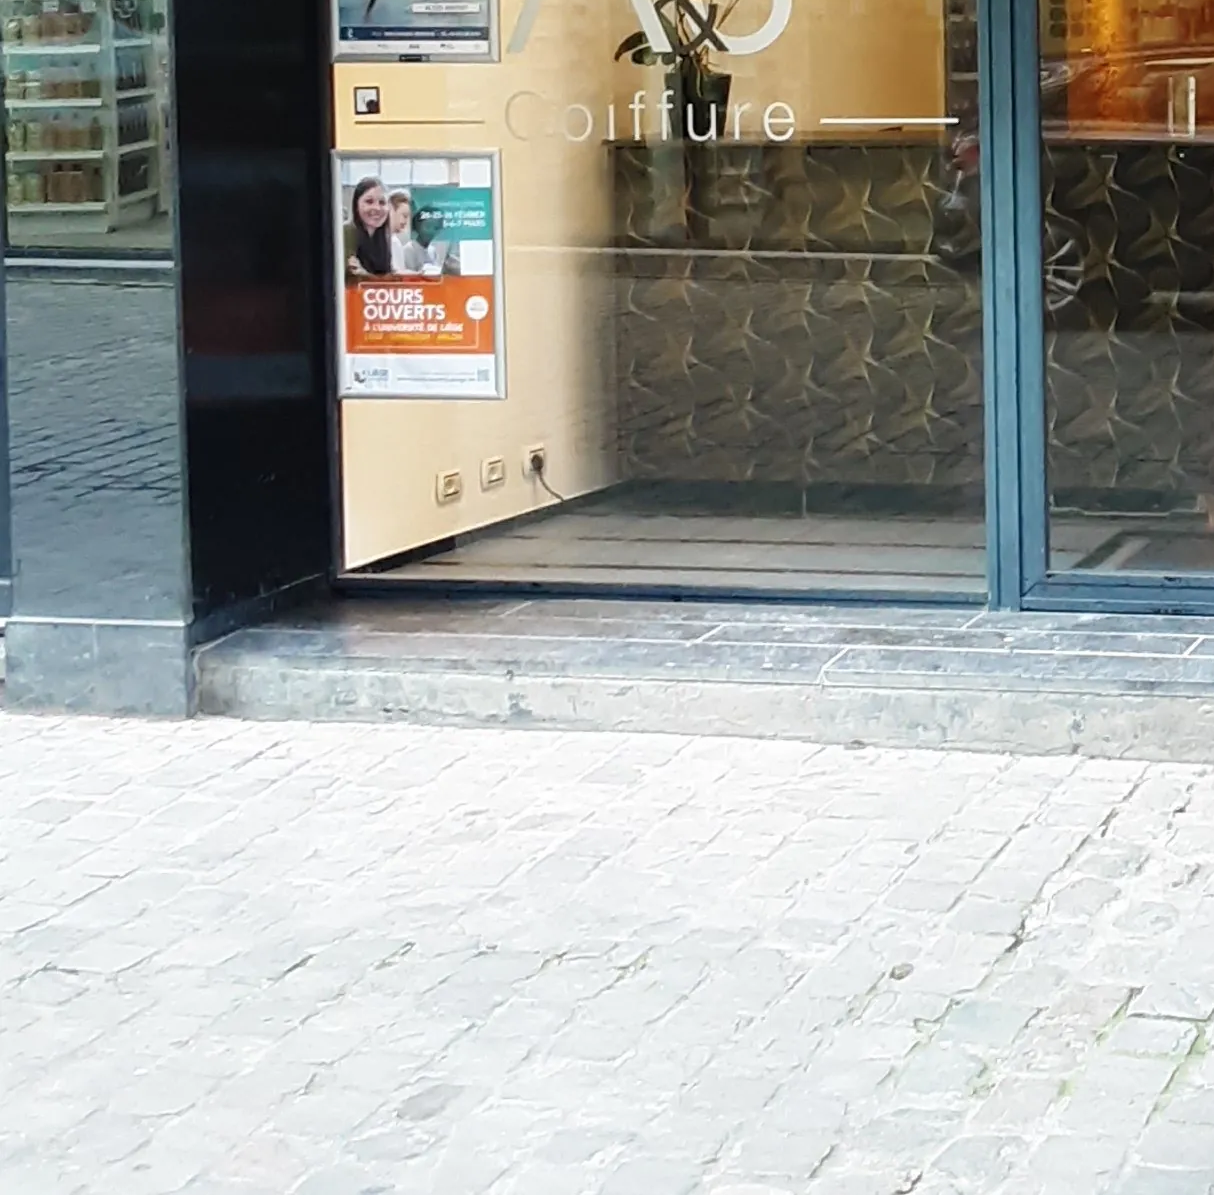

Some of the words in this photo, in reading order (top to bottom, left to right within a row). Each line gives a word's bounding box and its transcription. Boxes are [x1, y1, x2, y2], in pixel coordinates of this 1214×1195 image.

[504, 89, 798, 143] Coiffure
[363, 288, 424, 304] COURS
[363, 304, 446, 321] OUVERTS
